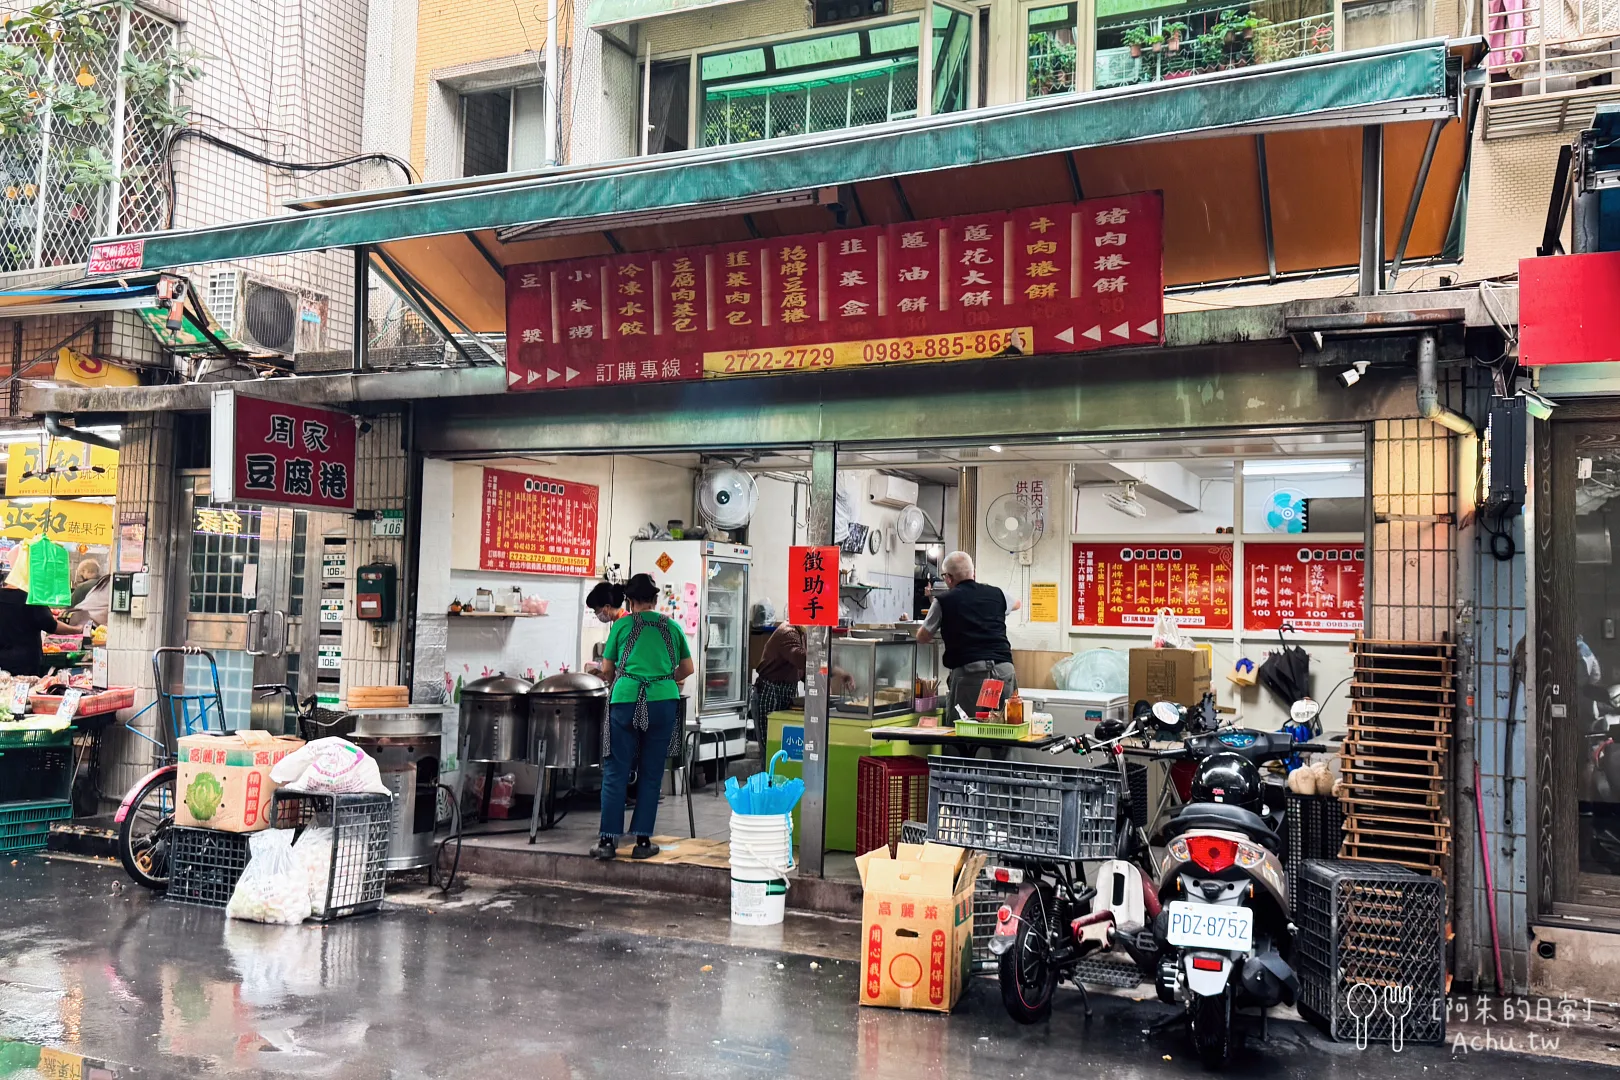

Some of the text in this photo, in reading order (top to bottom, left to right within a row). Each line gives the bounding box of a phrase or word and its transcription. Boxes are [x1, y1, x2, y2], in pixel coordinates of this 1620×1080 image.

[959, 224, 993, 307] 蔥花大餅
[1024, 217, 1061, 300] 牛肉捲餅
[1092, 207, 1130, 294] 豬肉捲餅
[725, 251, 752, 326] 韭菜肉包
[779, 245, 811, 324] 招牌豆腐捲
[897, 231, 929, 313] 蔥油餅
[520, 274, 544, 343] 豆漿
[568, 270, 593, 339] 小米粥
[617, 263, 648, 336] 冷凍水餃
[671, 257, 699, 333] 豆腐肉菜包
[724, 347, 835, 373] 2722-2729
[264, 414, 330, 453] 周家
[245, 453, 347, 500] 豆腐捲
[5, 500, 106, 536] 正和 蔬果行
[383, 523, 401, 534] 106
[327, 567, 340, 576] 106
[802, 551, 826, 620] 徵助手
[324, 612, 337, 621] 106
[1110, 605, 1123, 613] 40
[1137, 606, 1150, 614] 40
[1252, 609, 1270, 617] 100
[1276, 609, 1295, 617] 100
[1306, 610, 1328, 618] 100
[1340, 611, 1355, 619] 15
[322, 658, 335, 667] 106
[878, 901, 938, 920] 高麗菜
[868, 929, 881, 994] 用心栽培
